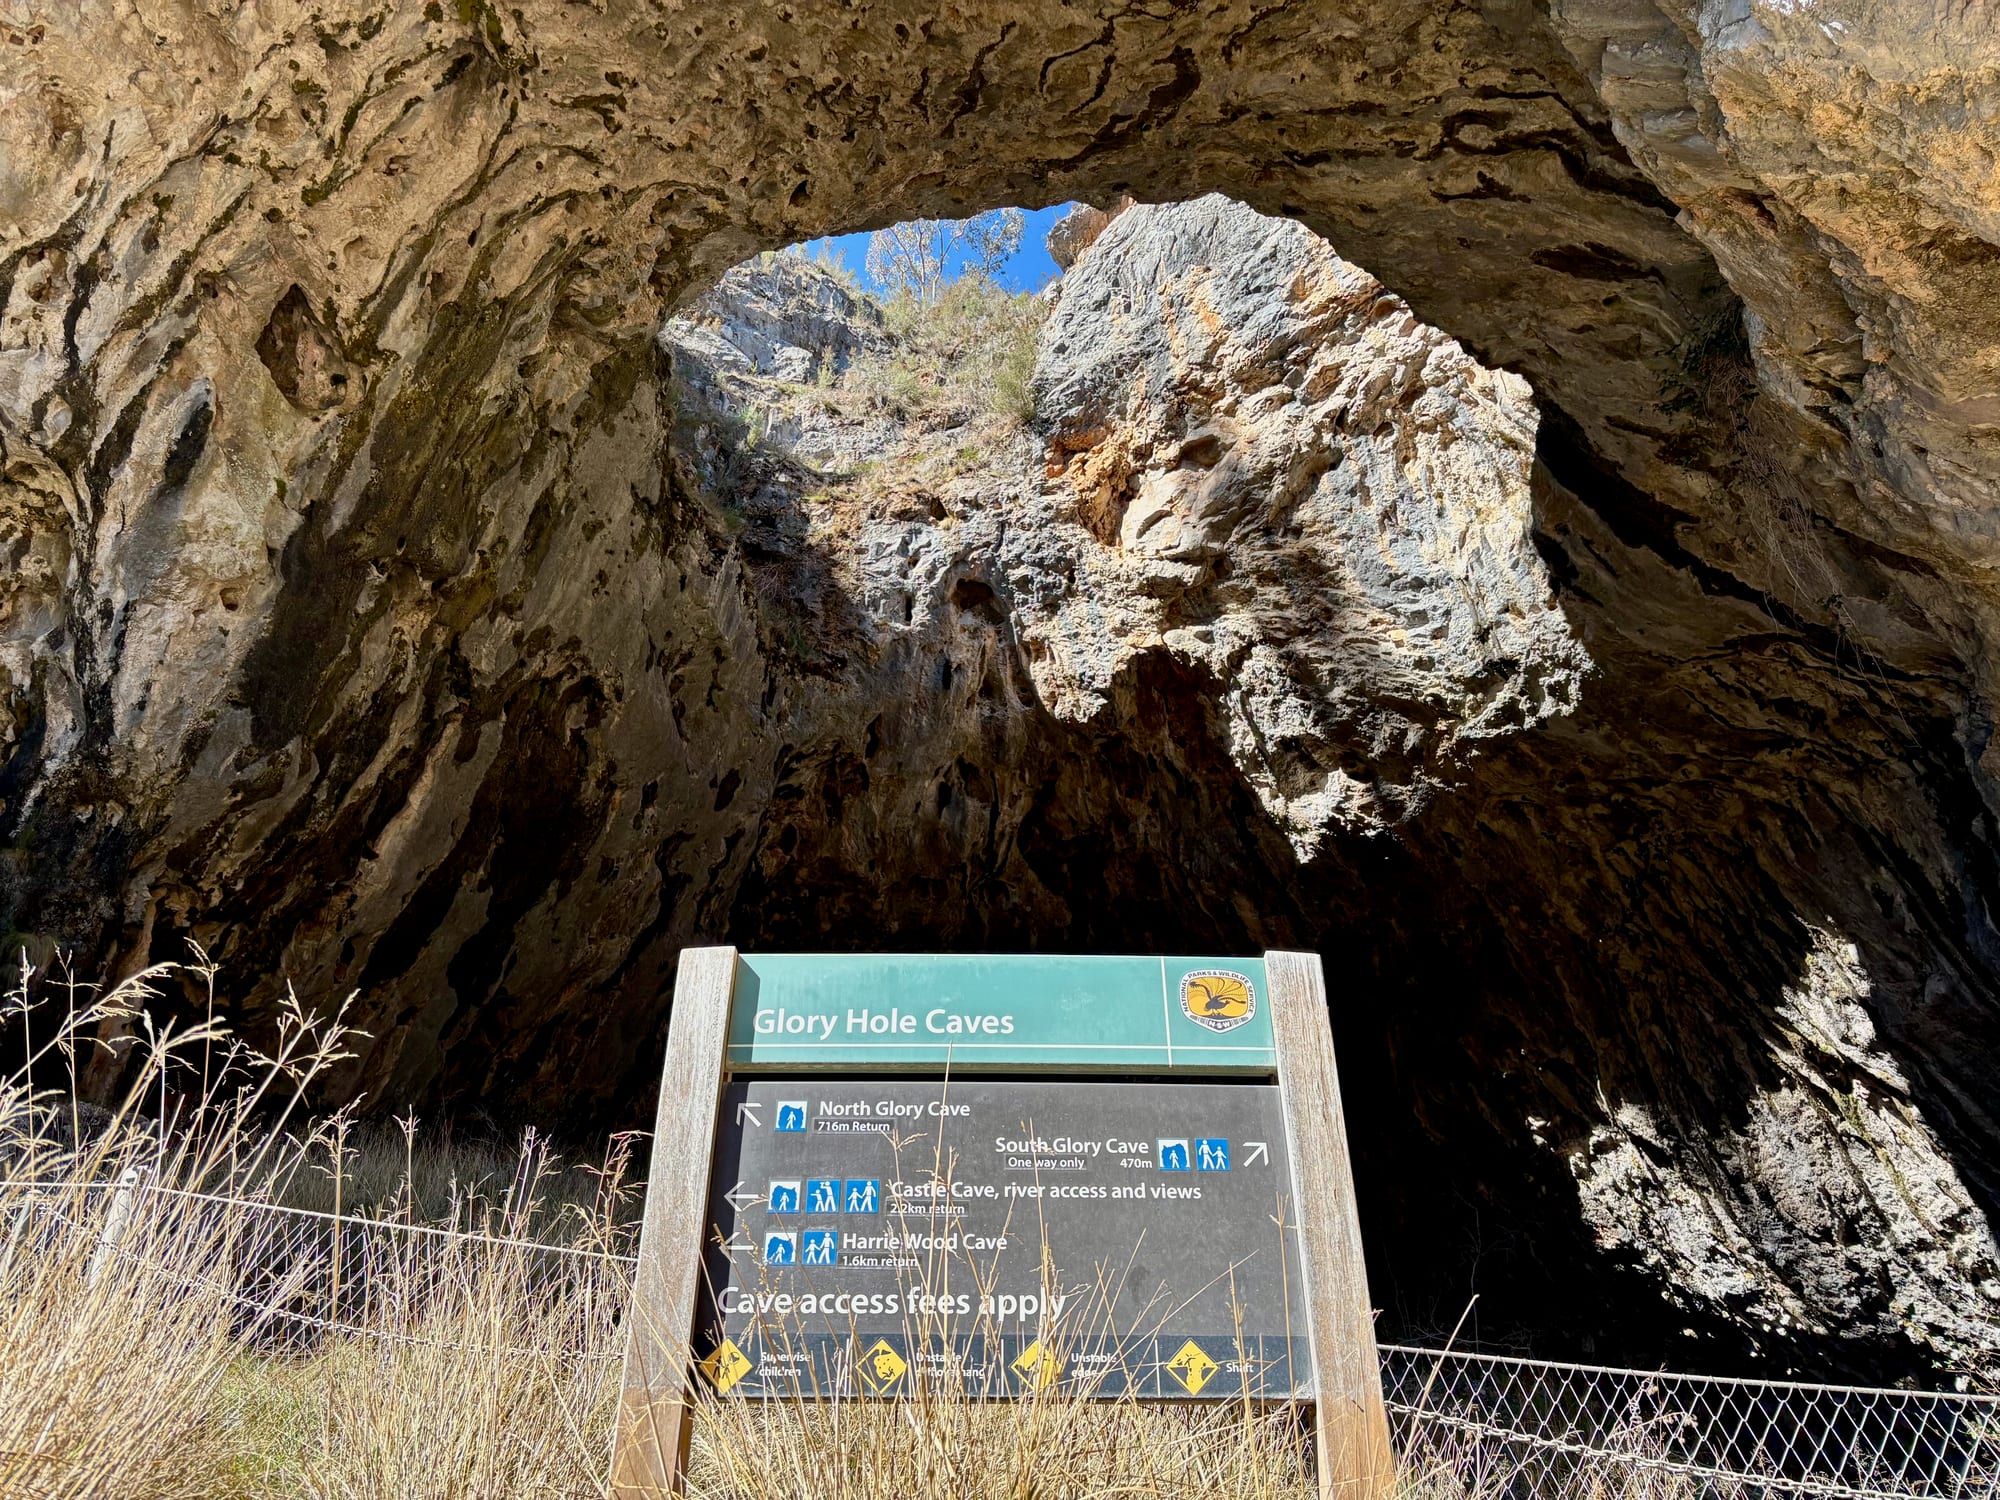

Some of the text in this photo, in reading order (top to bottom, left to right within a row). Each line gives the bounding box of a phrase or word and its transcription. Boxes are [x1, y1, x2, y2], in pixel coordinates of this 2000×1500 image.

[1181, 978, 1189, 1012] NATIONAL
[1218, 971, 1249, 984] WILDLIFE
[753, 1008, 1015, 1041] Glory Hole Caves
[819, 1100, 971, 1120] North Glory Cave
[818, 1121, 890, 1132] 716m Return
[995, 1137, 1149, 1157] South Glory Cave
[1008, 1156, 1085, 1170] One way only
[1120, 1158, 1153, 1169] 470m
[891, 1181, 1202, 1200] Castle Cave, river access and views
[929, 1204, 965, 1214] return
[842, 1232, 1008, 1250] Harrie Wood Cave
[842, 1255, 919, 1267] 1.6km return
[717, 1285, 1068, 1322] Cave access fees apply
[760, 1352, 812, 1364] Supervise
[916, 1352, 962, 1362] Unstale
[1226, 1362, 1255, 1373] Shft
